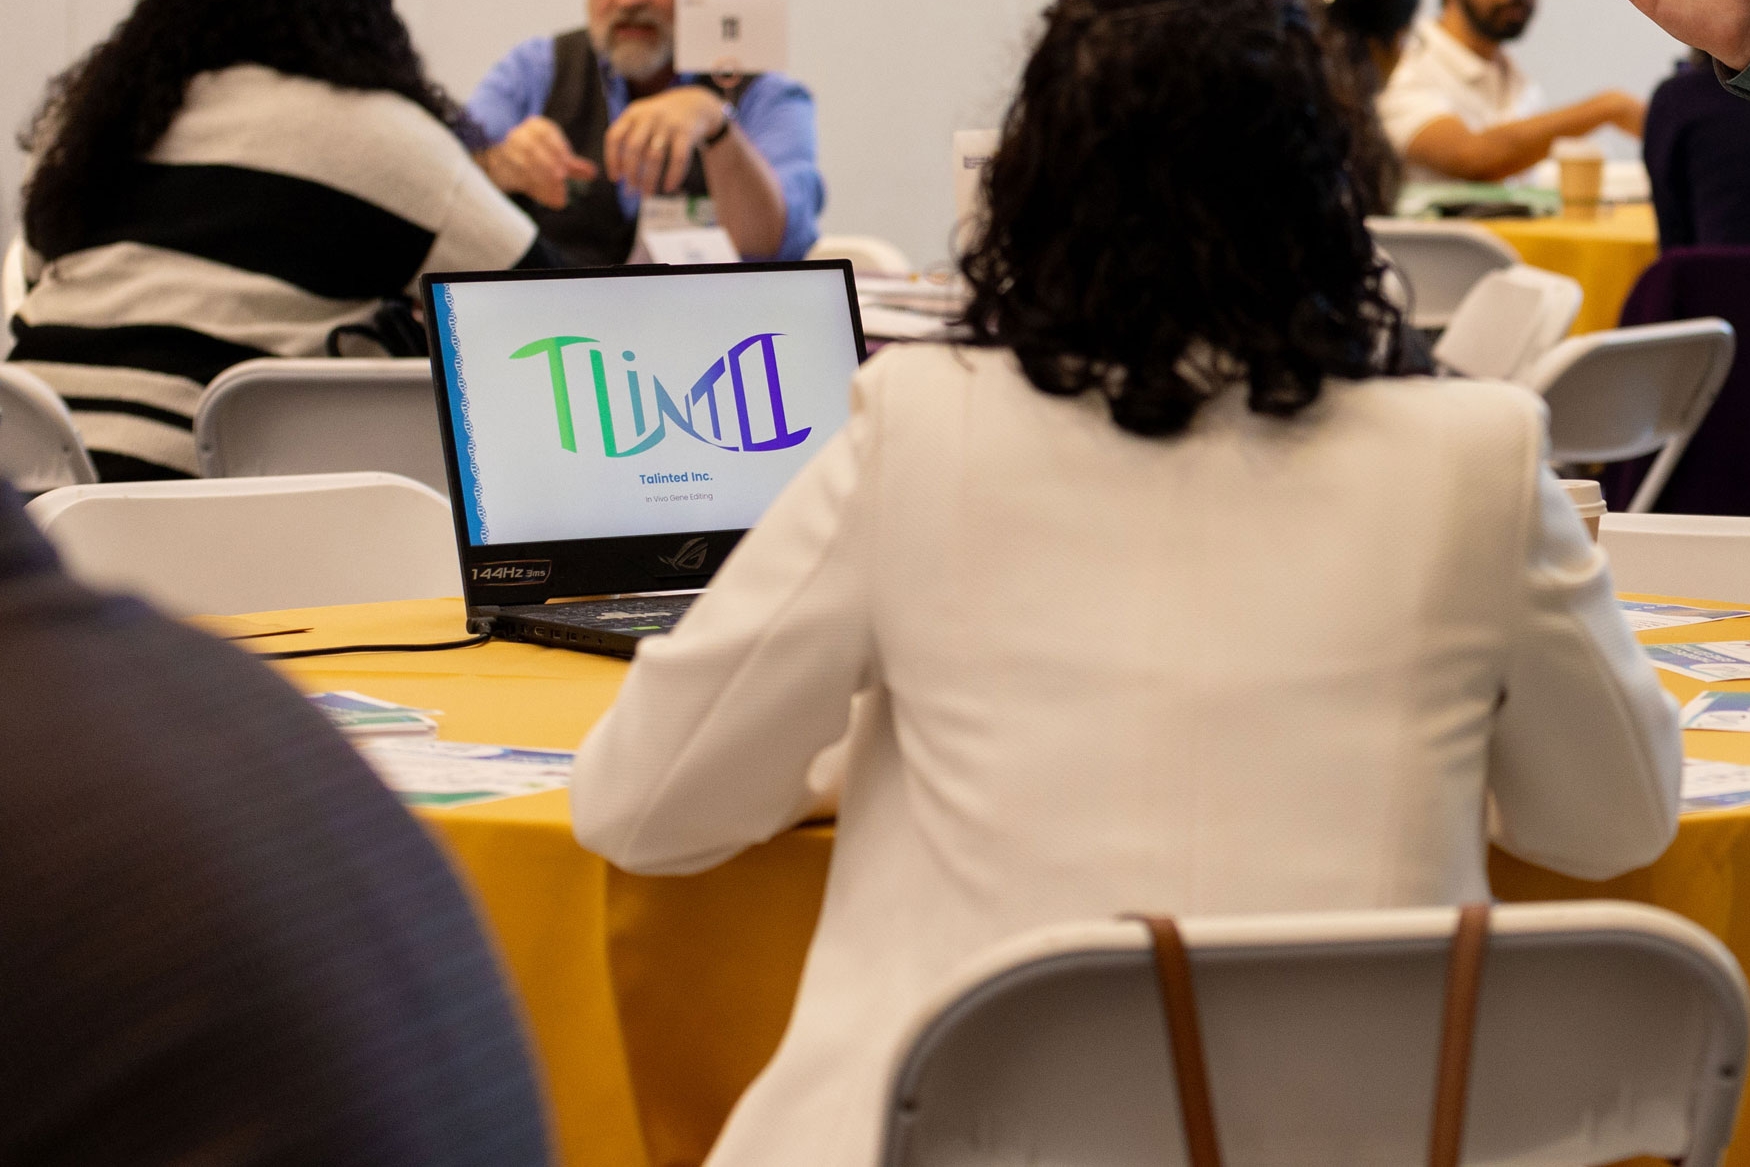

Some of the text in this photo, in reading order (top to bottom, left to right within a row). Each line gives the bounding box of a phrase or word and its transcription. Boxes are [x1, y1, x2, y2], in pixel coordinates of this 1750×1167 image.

[639, 471, 713, 484] Talinted Inc.
[653, 495, 669, 503] Vivo
[669, 494, 689, 502] Gene
[690, 493, 714, 501] Editing
[471, 566, 546, 580] 144Hz 3ms
